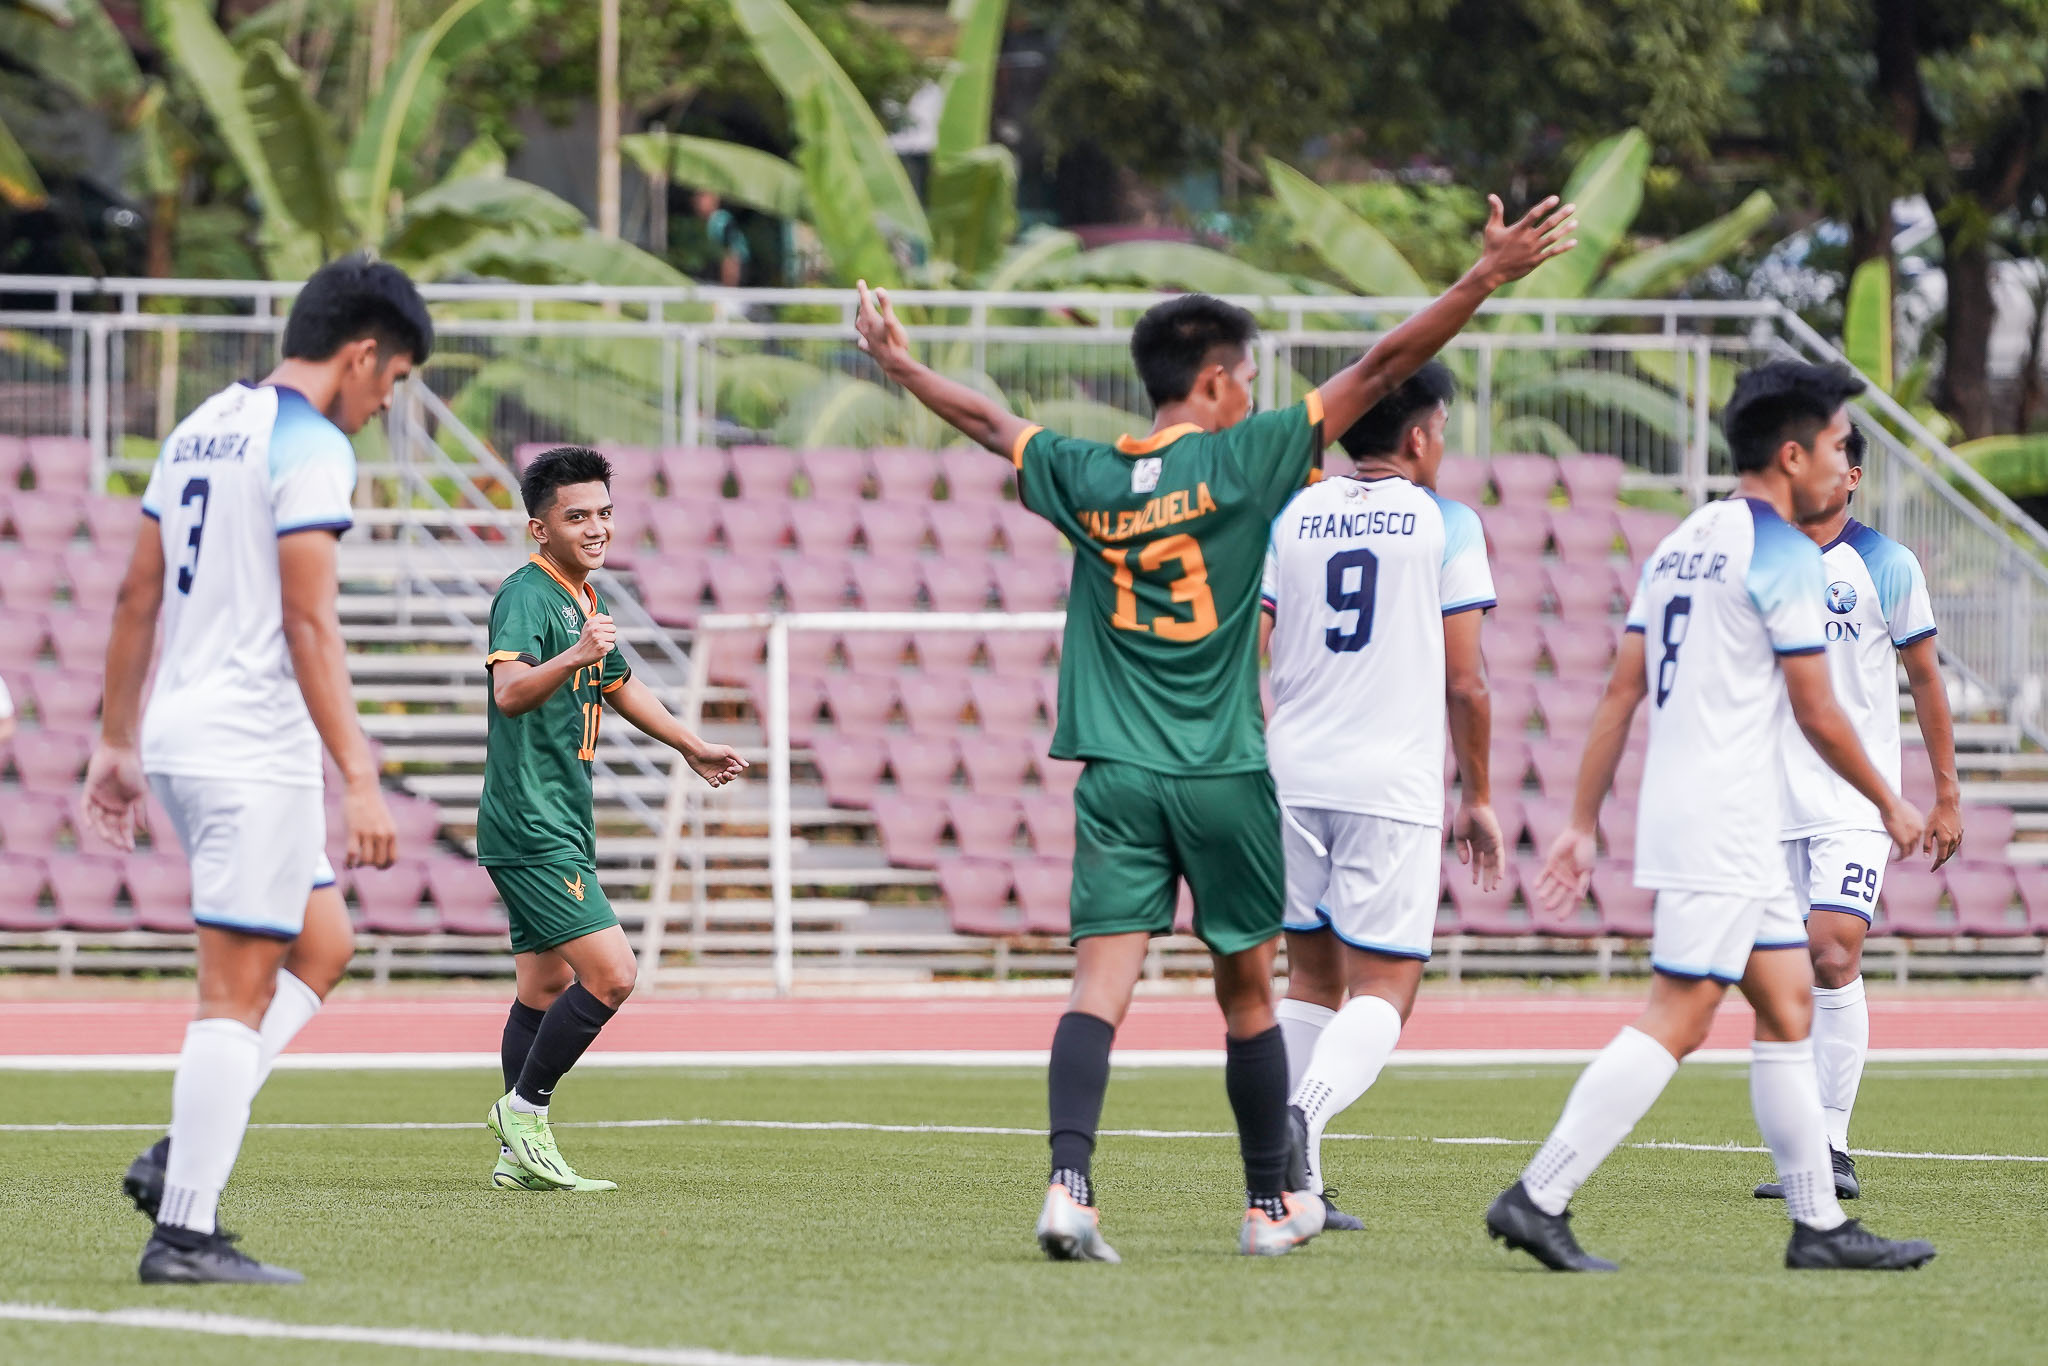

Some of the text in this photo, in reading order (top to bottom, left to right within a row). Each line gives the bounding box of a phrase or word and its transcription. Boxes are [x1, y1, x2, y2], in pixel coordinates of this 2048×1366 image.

[178, 476, 210, 595] 3
[1298, 511, 1416, 539] FRANCISCO
[1101, 533, 1219, 642] 13
[1325, 548, 1379, 653] 9
[1825, 621, 1861, 642] ON
[1657, 595, 1692, 709] 8
[1840, 862, 1877, 903] 29
